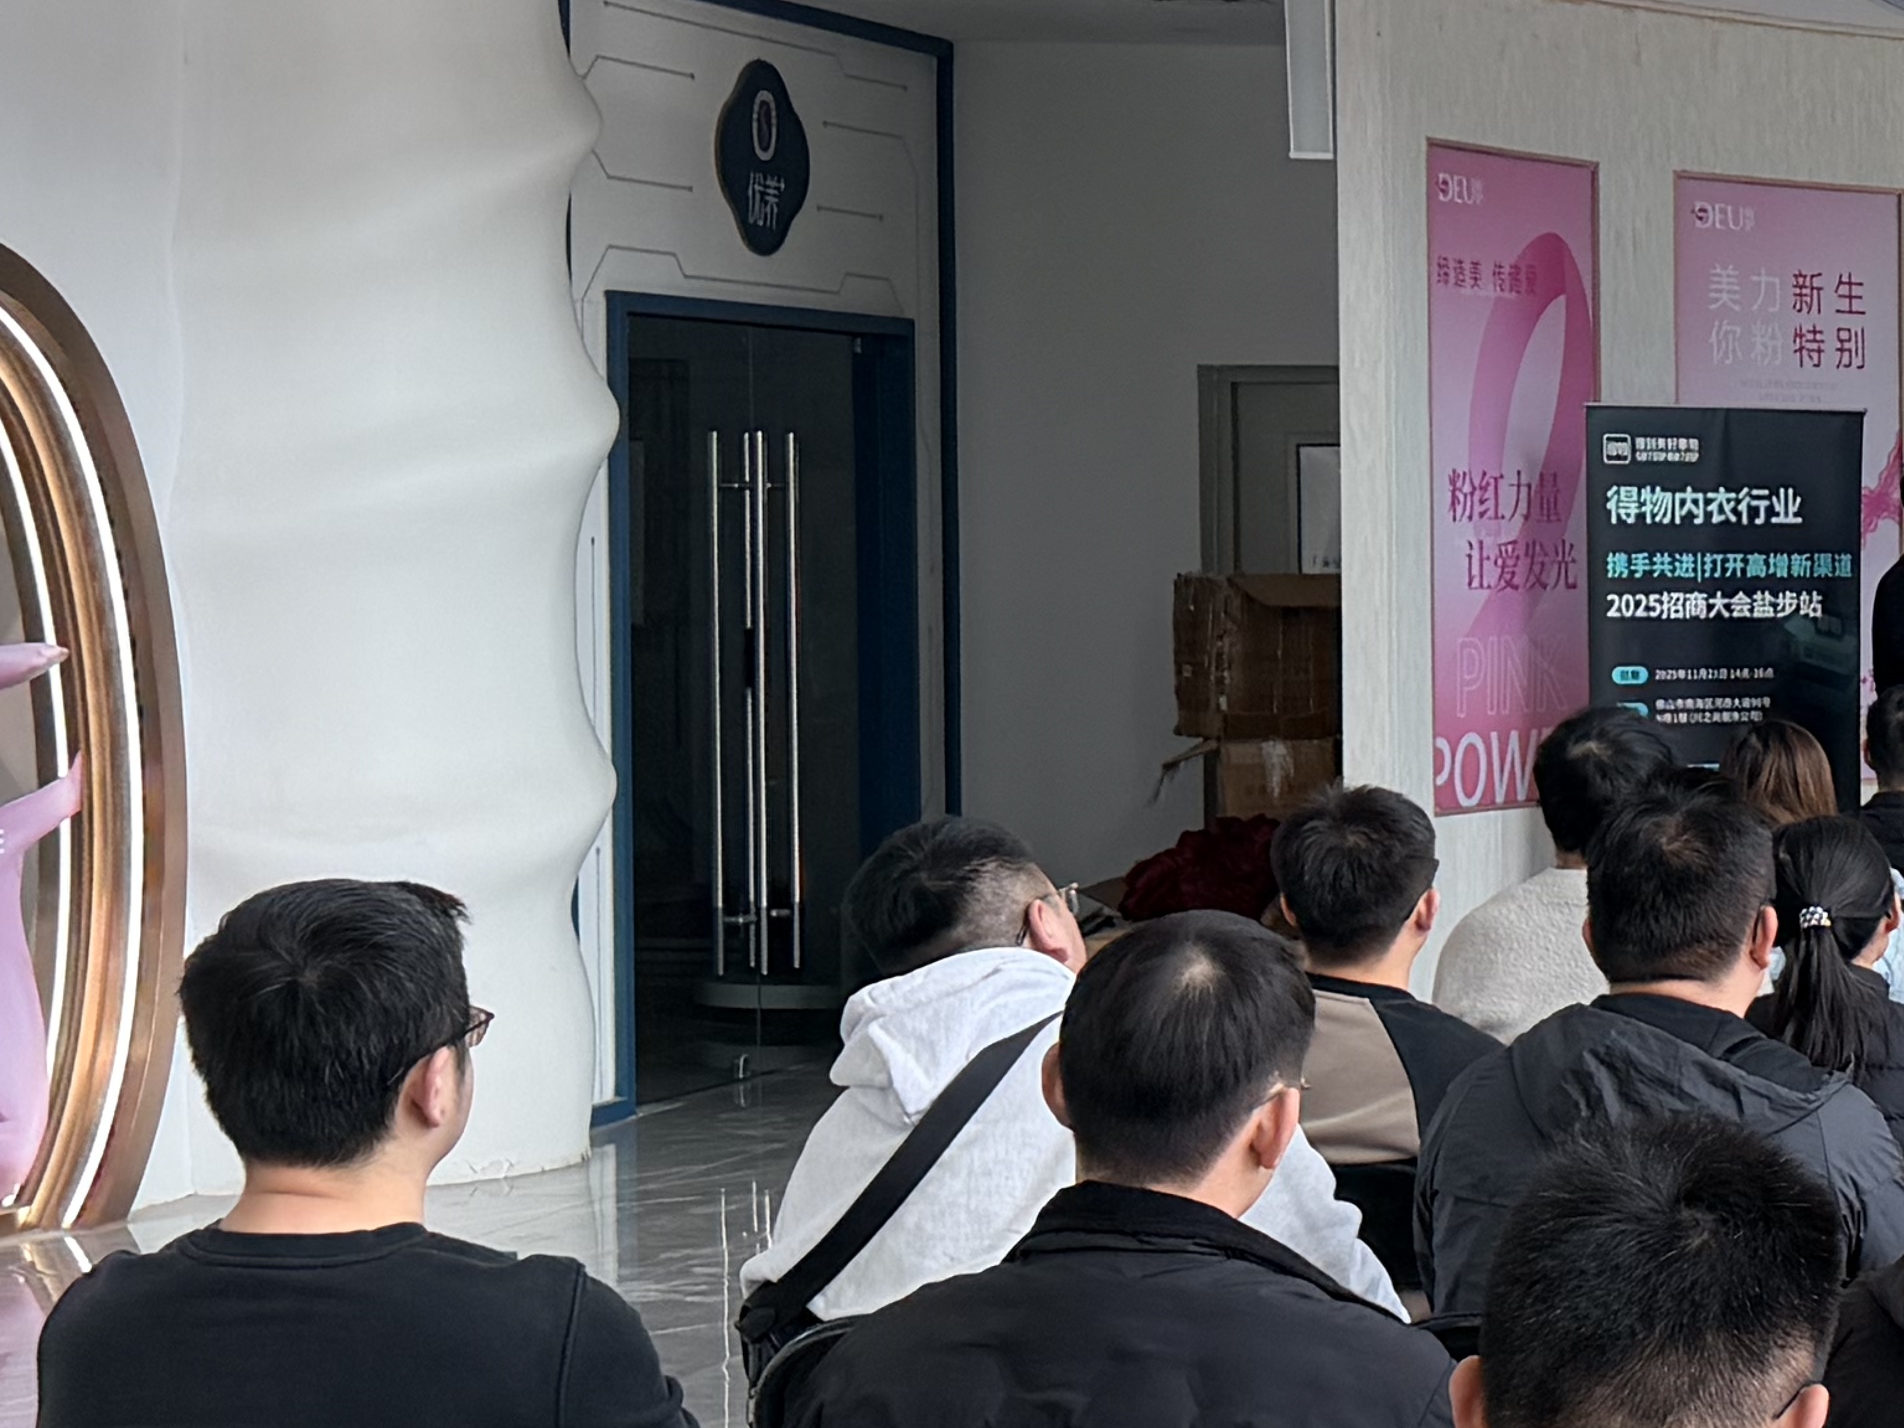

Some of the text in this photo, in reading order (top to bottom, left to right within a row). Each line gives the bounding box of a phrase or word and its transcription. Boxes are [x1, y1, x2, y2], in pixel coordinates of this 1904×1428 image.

[1448, 468, 1563, 523] 粉红力量
[1606, 485, 1803, 525] 得物内衣行业
[1466, 538, 1578, 593] 让爱发光
[1606, 590, 1823, 620] 2025招商大会盐步站
[1457, 636, 1568, 718] PINK
[1435, 727, 1554, 808] POW
